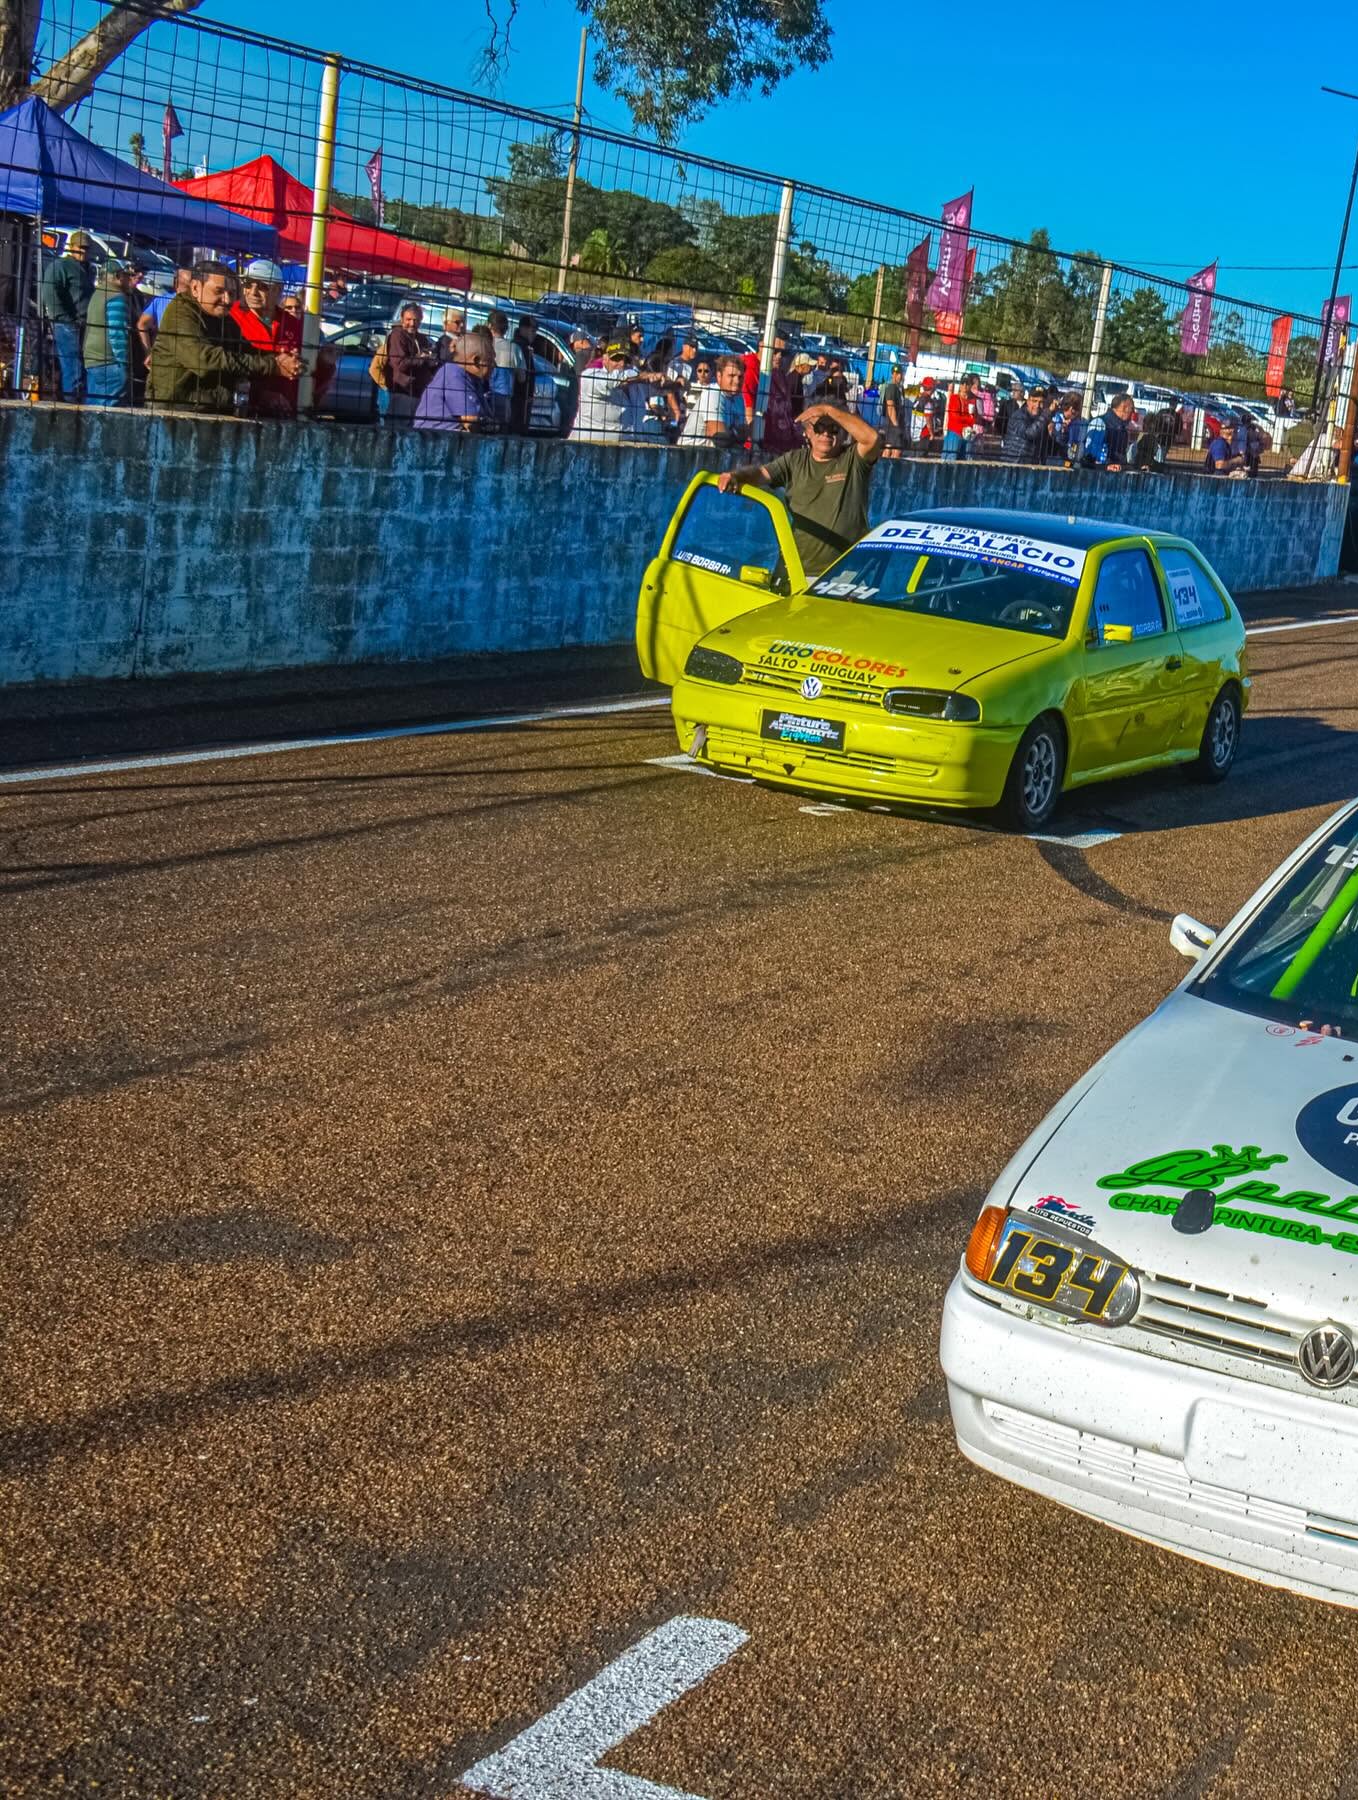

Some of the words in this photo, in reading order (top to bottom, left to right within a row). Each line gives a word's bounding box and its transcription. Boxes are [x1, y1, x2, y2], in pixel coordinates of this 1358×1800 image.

[880, 528, 935, 541] DEL
[944, 532, 1075, 568] PALACIO
[990, 533, 1034, 546] GARAGE
[814, 581, 880, 600] 434
[1173, 586, 1198, 605] 434
[758, 655, 798, 670] SALTO
[810, 663, 877, 684] URUGUAY
[1050, 1214, 1091, 1234] REPUESTOS
[988, 1229, 1129, 1319] 134
